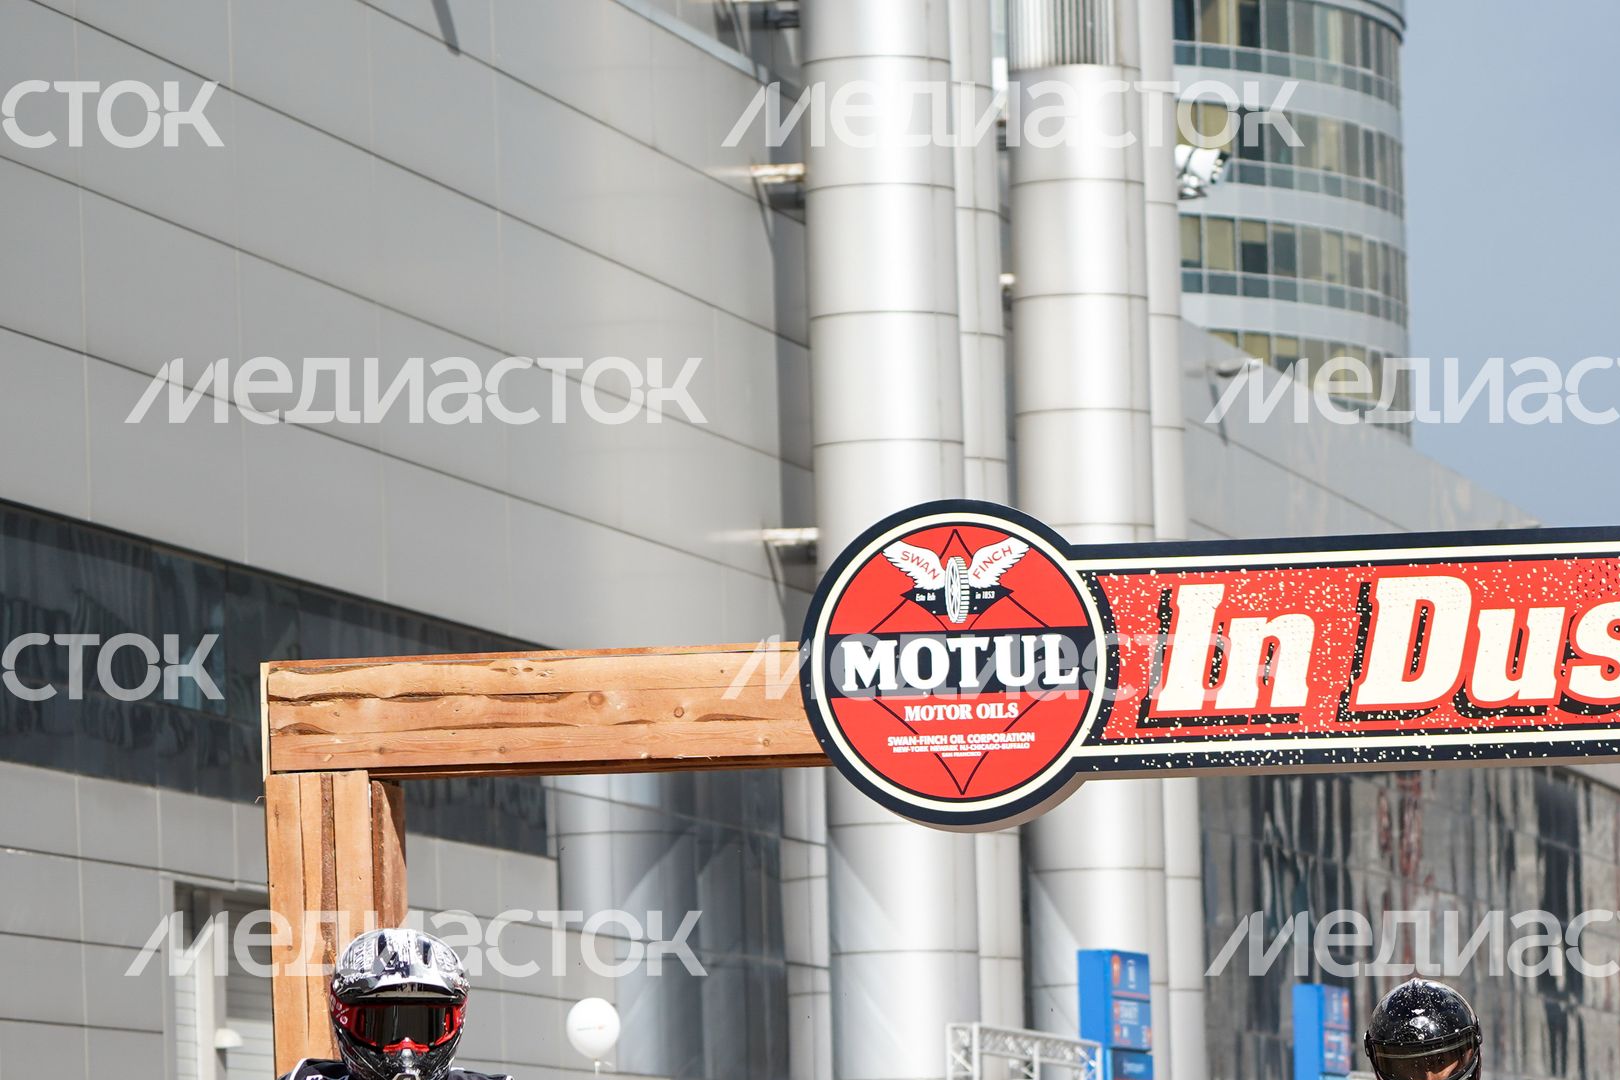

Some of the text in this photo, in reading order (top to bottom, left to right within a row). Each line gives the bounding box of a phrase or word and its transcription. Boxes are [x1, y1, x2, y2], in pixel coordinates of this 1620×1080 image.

[901, 545, 1013, 580] SWAN FINCH
[841, 634, 1079, 692] MOTUL
[1145, 582, 1317, 721] In
[904, 702, 1019, 721] MOTOR OILS
[887, 732, 1035, 746] SWAN-FINCH OIL CORPORATION
